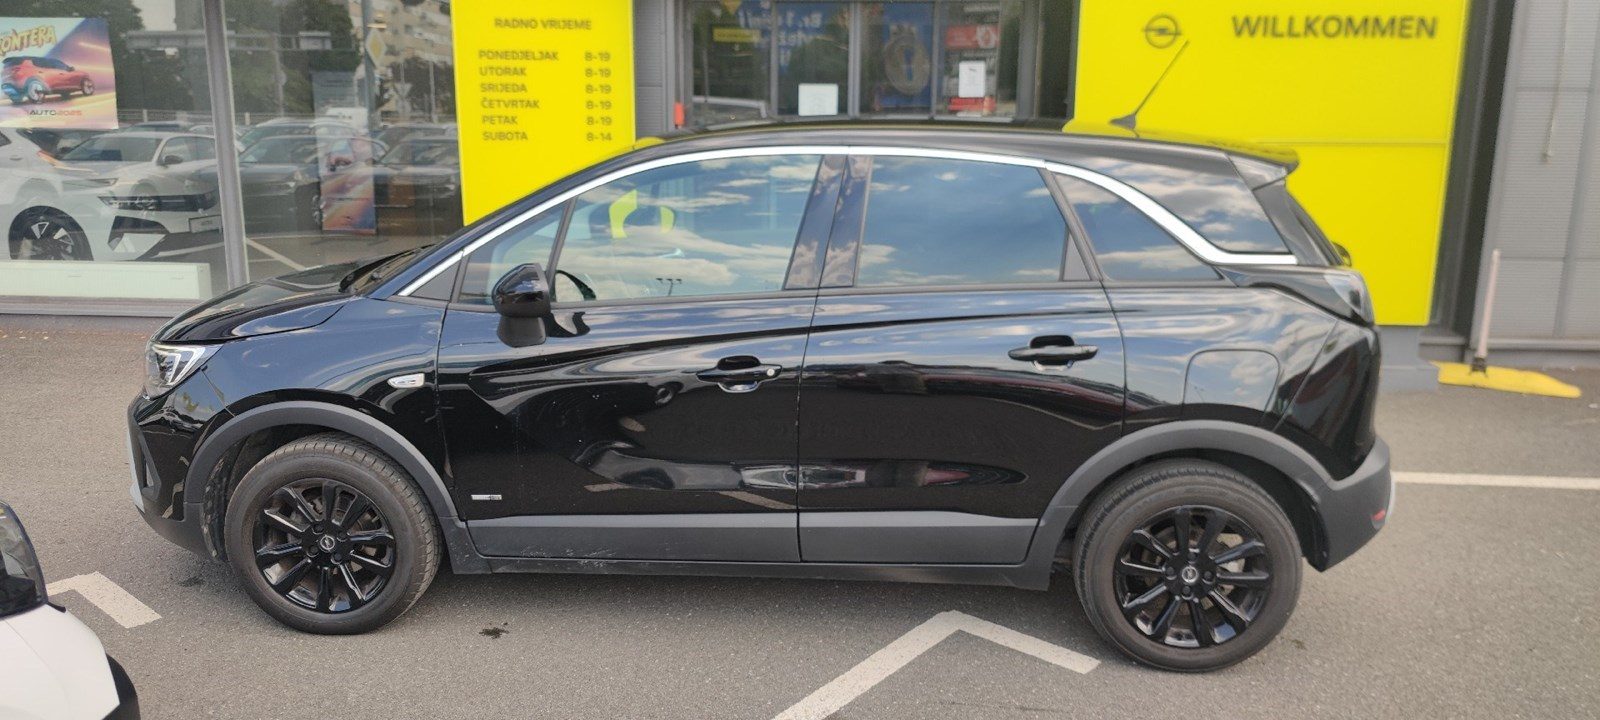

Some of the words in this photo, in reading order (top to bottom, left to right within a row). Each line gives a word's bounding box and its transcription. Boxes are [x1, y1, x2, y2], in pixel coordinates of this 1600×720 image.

[495, 18, 537, 30] RADNO
[541, 19, 592, 31] VRIJEME
[1231, 15, 1437, 39] WILLKOMMEN
[478, 50, 559, 61] PONEDJELJAK
[479, 66, 527, 77] UTORAK
[480, 82, 528, 93] SRIJEDA
[480, 97, 540, 109] ČETVRTAK
[482, 115, 518, 125] PETAK
[483, 131, 528, 141] SUBOTA
